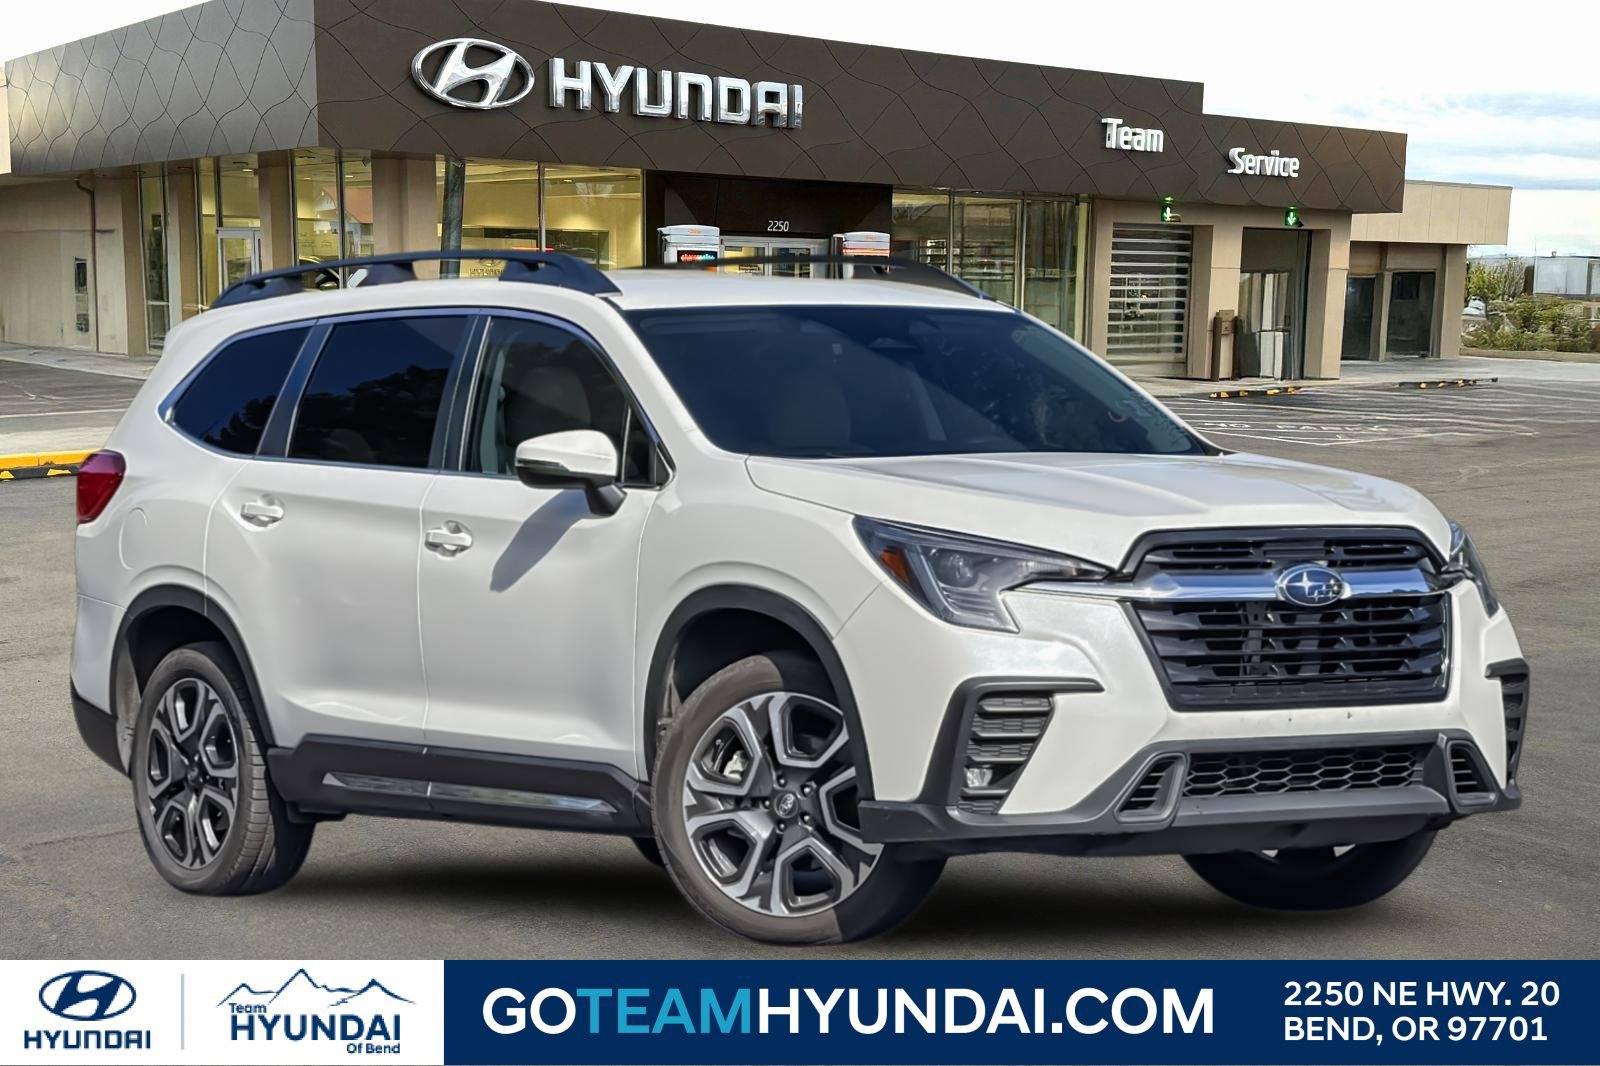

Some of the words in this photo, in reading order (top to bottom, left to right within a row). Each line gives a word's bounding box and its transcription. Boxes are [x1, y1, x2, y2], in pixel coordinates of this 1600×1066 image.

[549, 57, 803, 129] HYUNDAI
[1101, 117, 1164, 153] Team
[1227, 147, 1300, 178] Service
[767, 220, 790, 232] 2250
